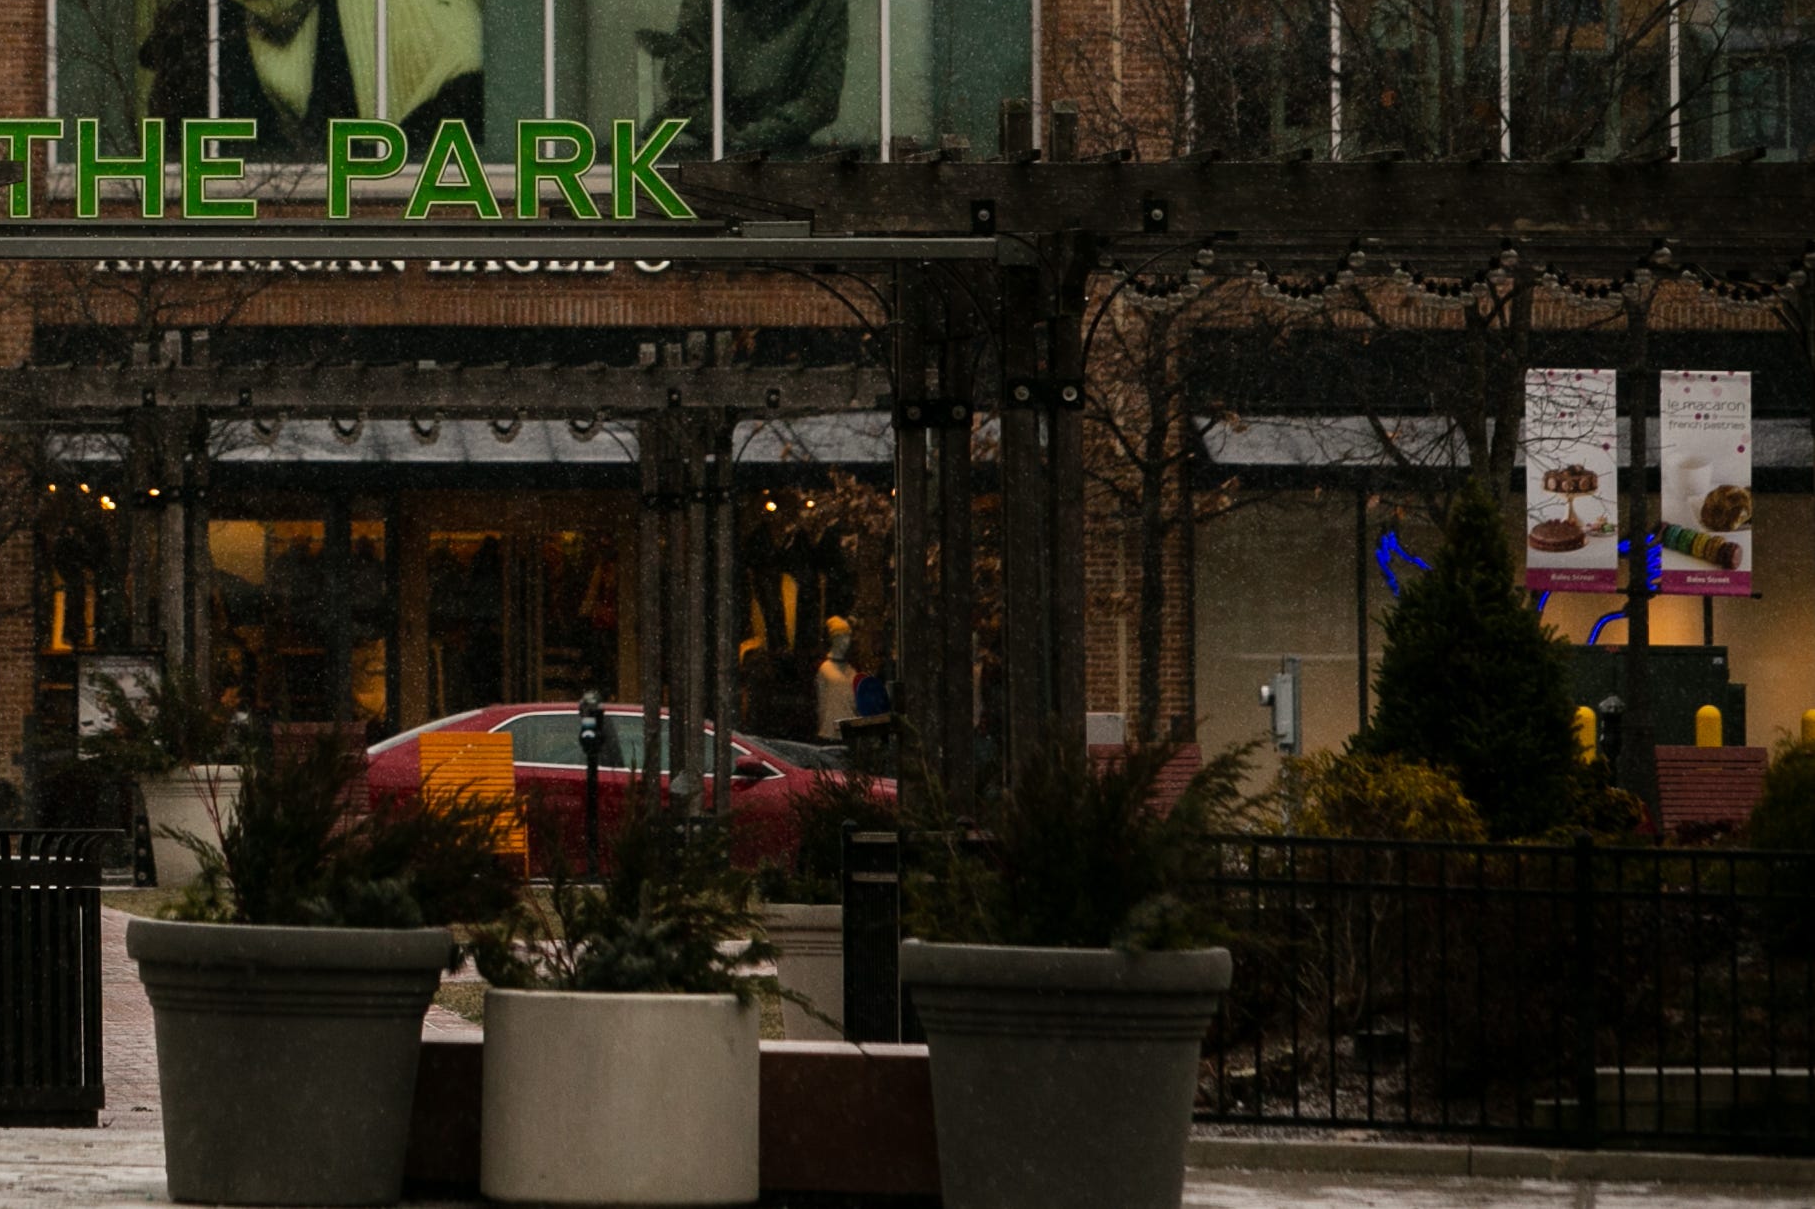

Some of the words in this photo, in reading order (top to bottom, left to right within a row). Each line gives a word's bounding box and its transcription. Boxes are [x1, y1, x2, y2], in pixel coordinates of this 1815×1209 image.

[327, 118, 698, 220] PARK
[1682, 399, 1746, 411] macaron
[1668, 419, 1702, 431] french
